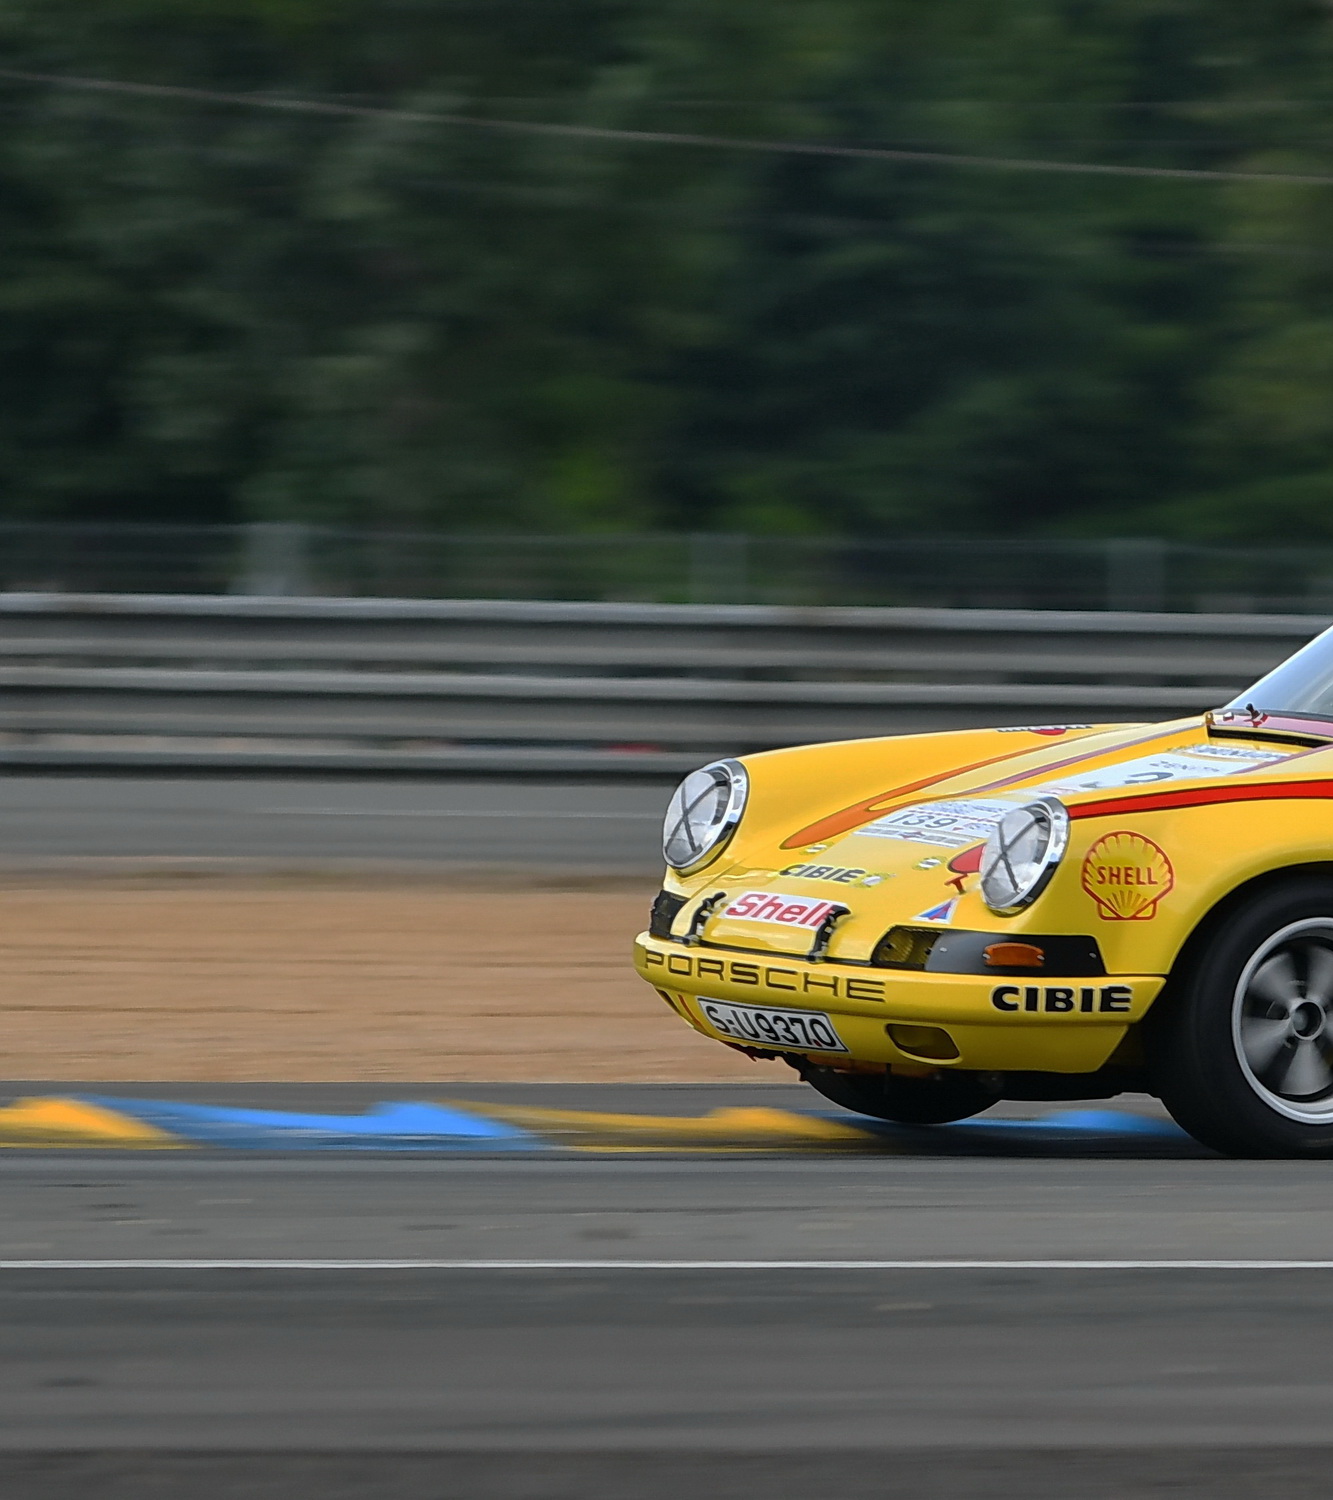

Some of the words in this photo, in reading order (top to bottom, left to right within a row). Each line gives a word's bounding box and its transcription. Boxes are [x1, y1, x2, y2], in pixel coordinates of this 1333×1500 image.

[1096, 865, 1159, 886] SHELL
[724, 893, 835, 928] Shell
[645, 949, 887, 1004] PORSCHE
